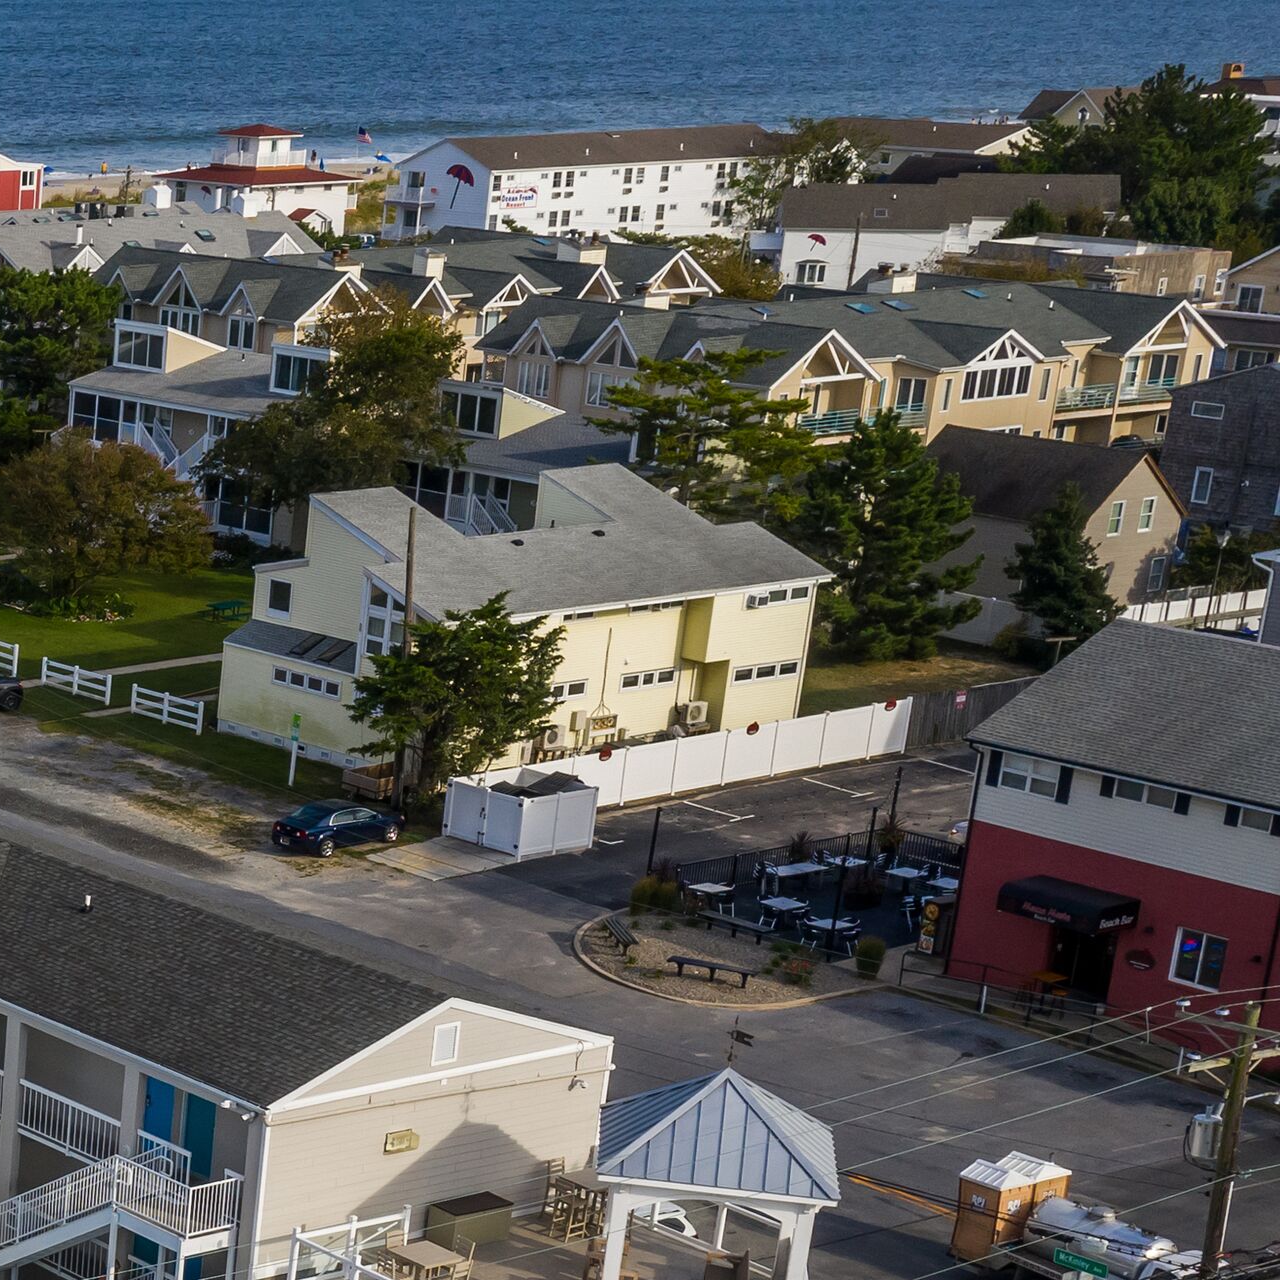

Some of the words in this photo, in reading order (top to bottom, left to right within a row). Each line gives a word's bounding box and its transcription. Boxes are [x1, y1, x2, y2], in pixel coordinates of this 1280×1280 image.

[1099, 918, 1120, 929] Beach
[1120, 914, 1135, 926] Bar
[1059, 1252, 1089, 1271] McKinley
